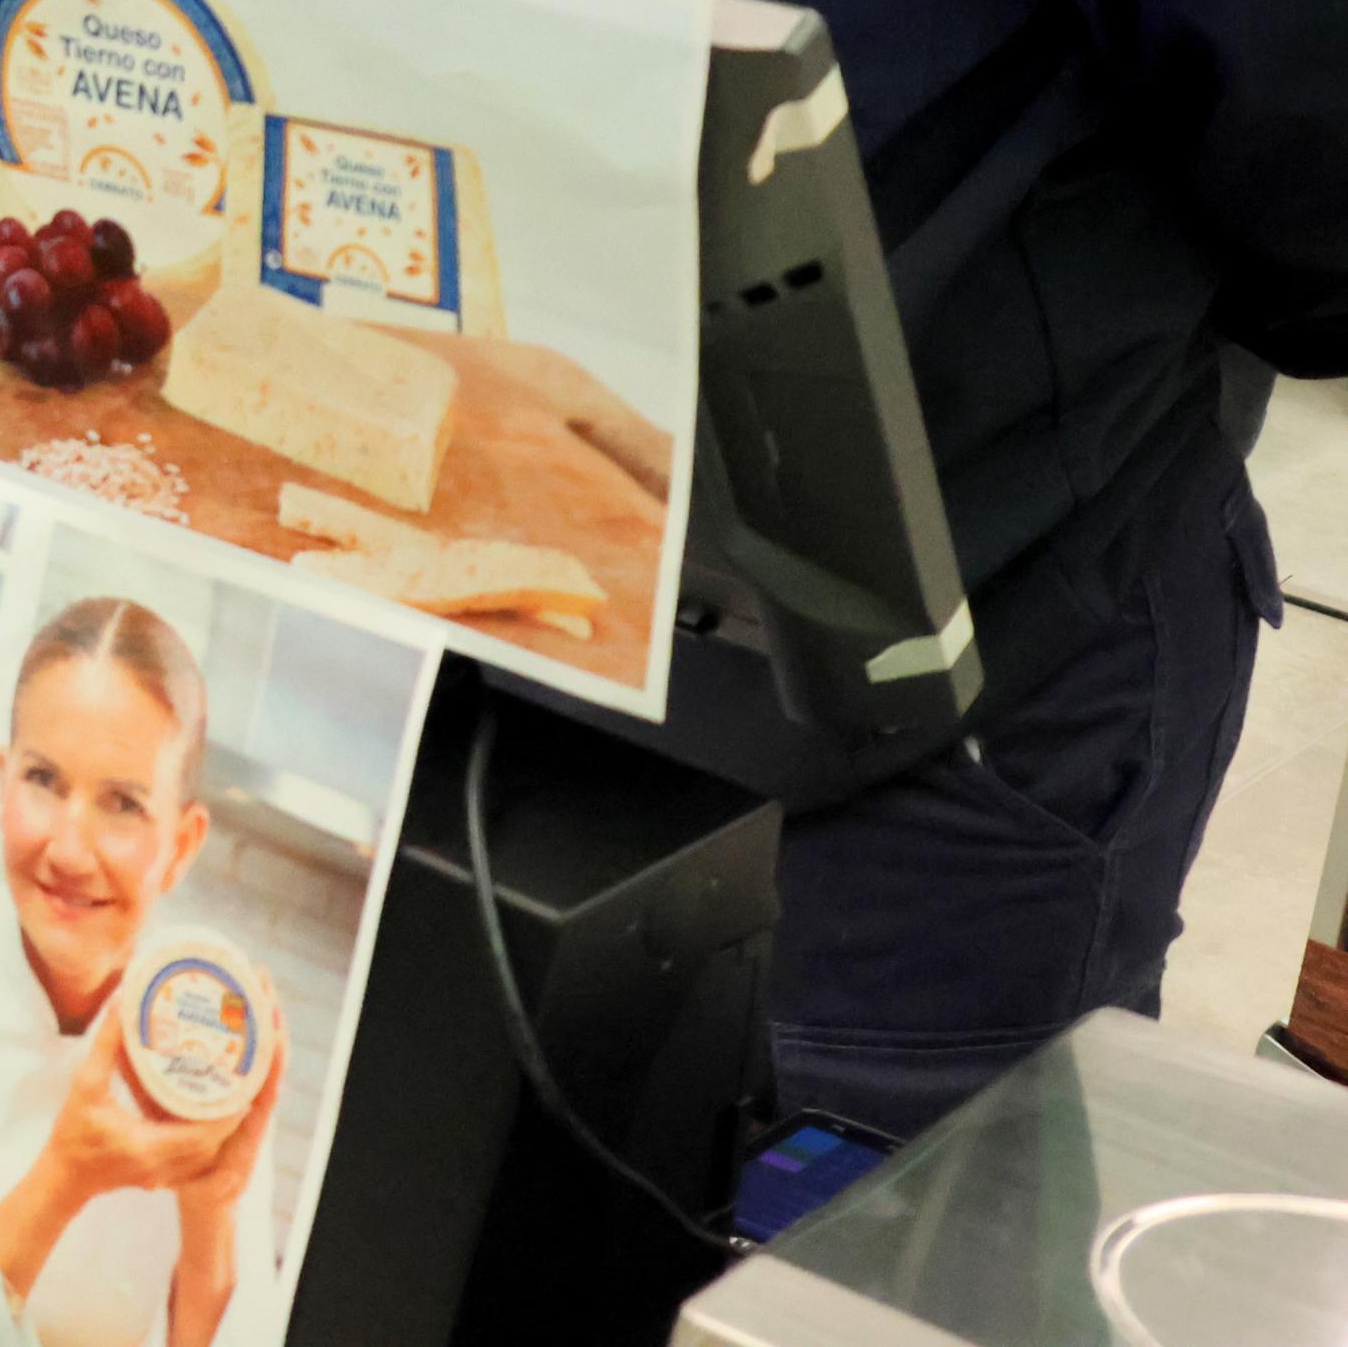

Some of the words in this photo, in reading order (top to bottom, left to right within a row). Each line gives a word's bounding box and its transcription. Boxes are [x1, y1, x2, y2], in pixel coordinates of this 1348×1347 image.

[83, 13, 161, 50] Queso
[59, 34, 135, 72] Tierno
[143, 56, 186, 82] con
[71, 68, 184, 121] AVENA
[326, 189, 401, 222] AVENA
